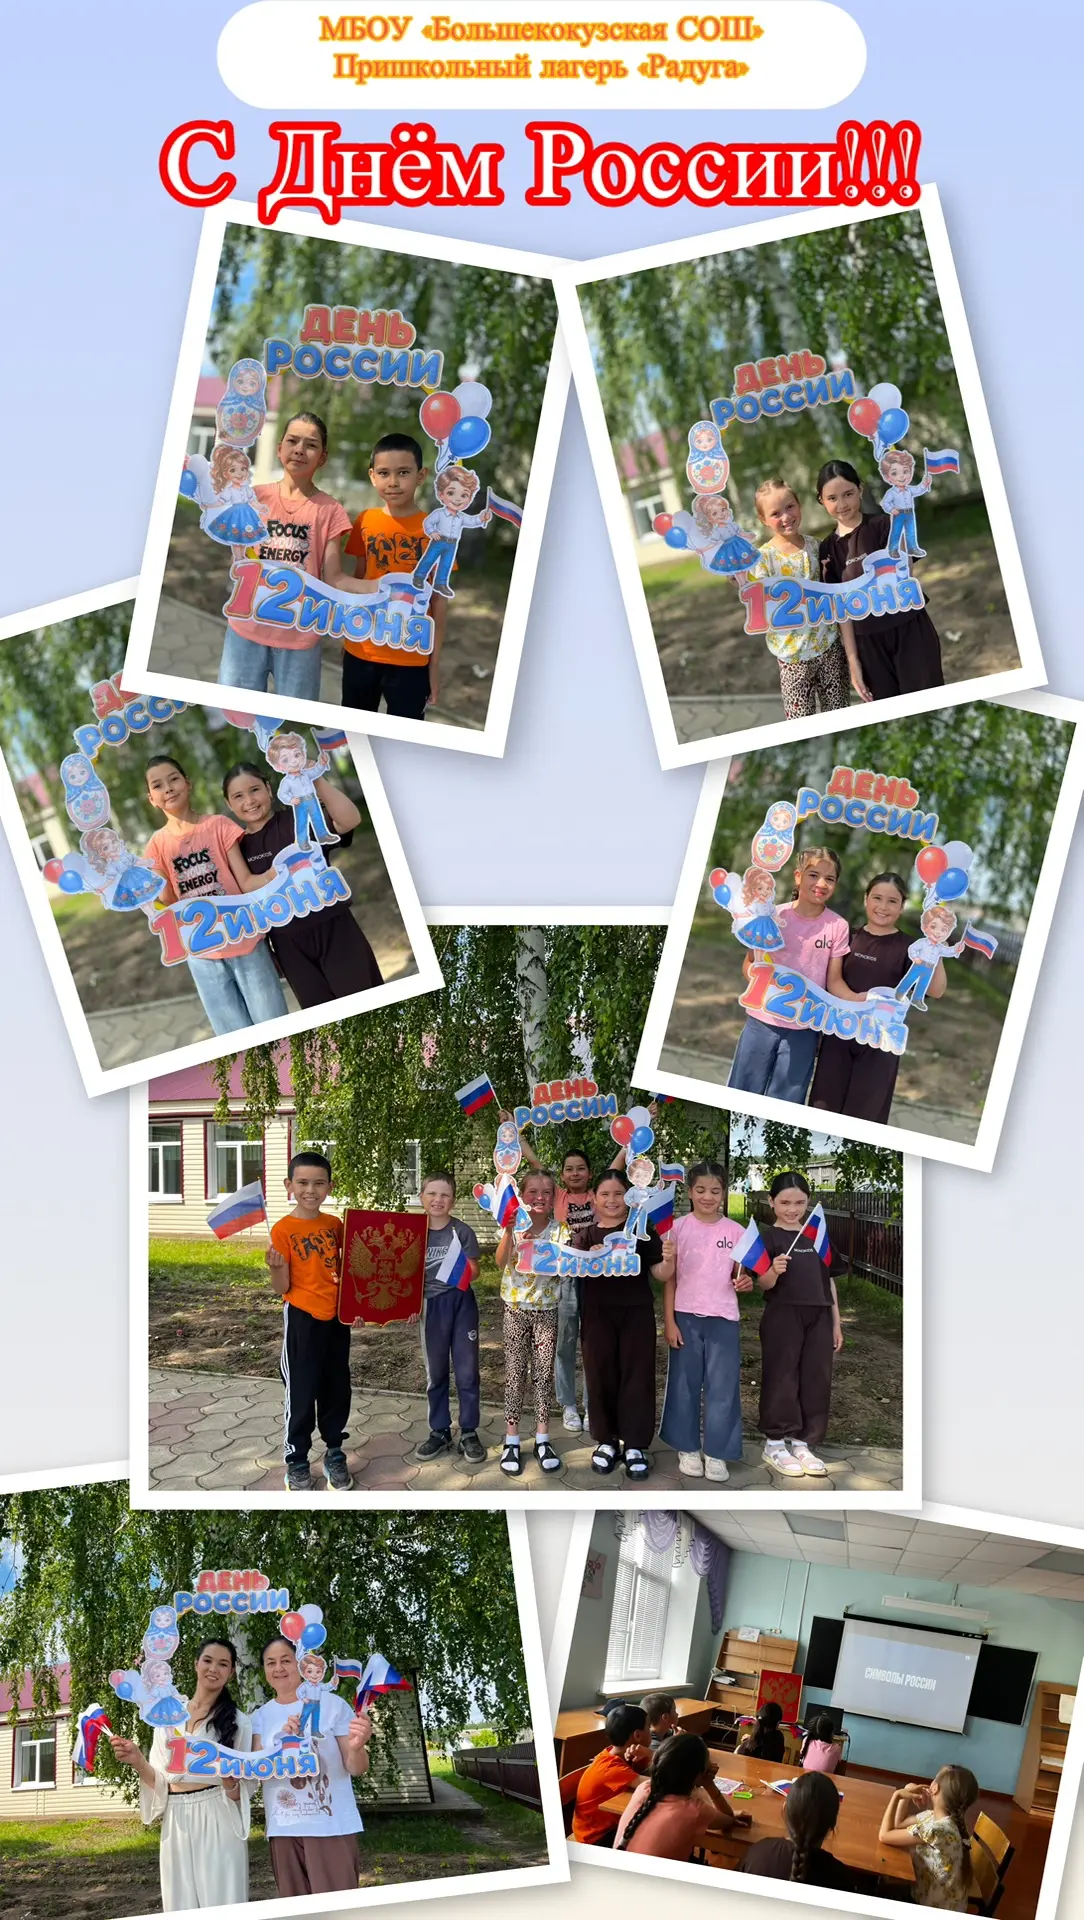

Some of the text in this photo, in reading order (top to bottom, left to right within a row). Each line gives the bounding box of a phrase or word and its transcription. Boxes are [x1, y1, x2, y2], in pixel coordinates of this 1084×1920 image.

[300, 305, 415, 348] ДЕНЬ
[265, 339, 443, 387] РОССИИ
[734, 349, 826, 396] ДЕНЬ
[711, 368, 855, 429] РОССИИ
[259, 546, 309, 563] ENERGY
[73, 696, 196, 759] РОСС
[826, 766, 920, 810] ДЕНЬ
[797, 787, 939, 843] РОССИИ
[178, 870, 218, 894] ENERGY
[514, 1093, 618, 1129] РОССИИ
[532, 1077, 599, 1107] ДЕНЬ
[196, 1569, 270, 1592] ДЕНЬ
[173, 1588, 290, 1615] РОССИИ
[865, 1667, 937, 1691] СИМВОЛЫ РОССИИ
